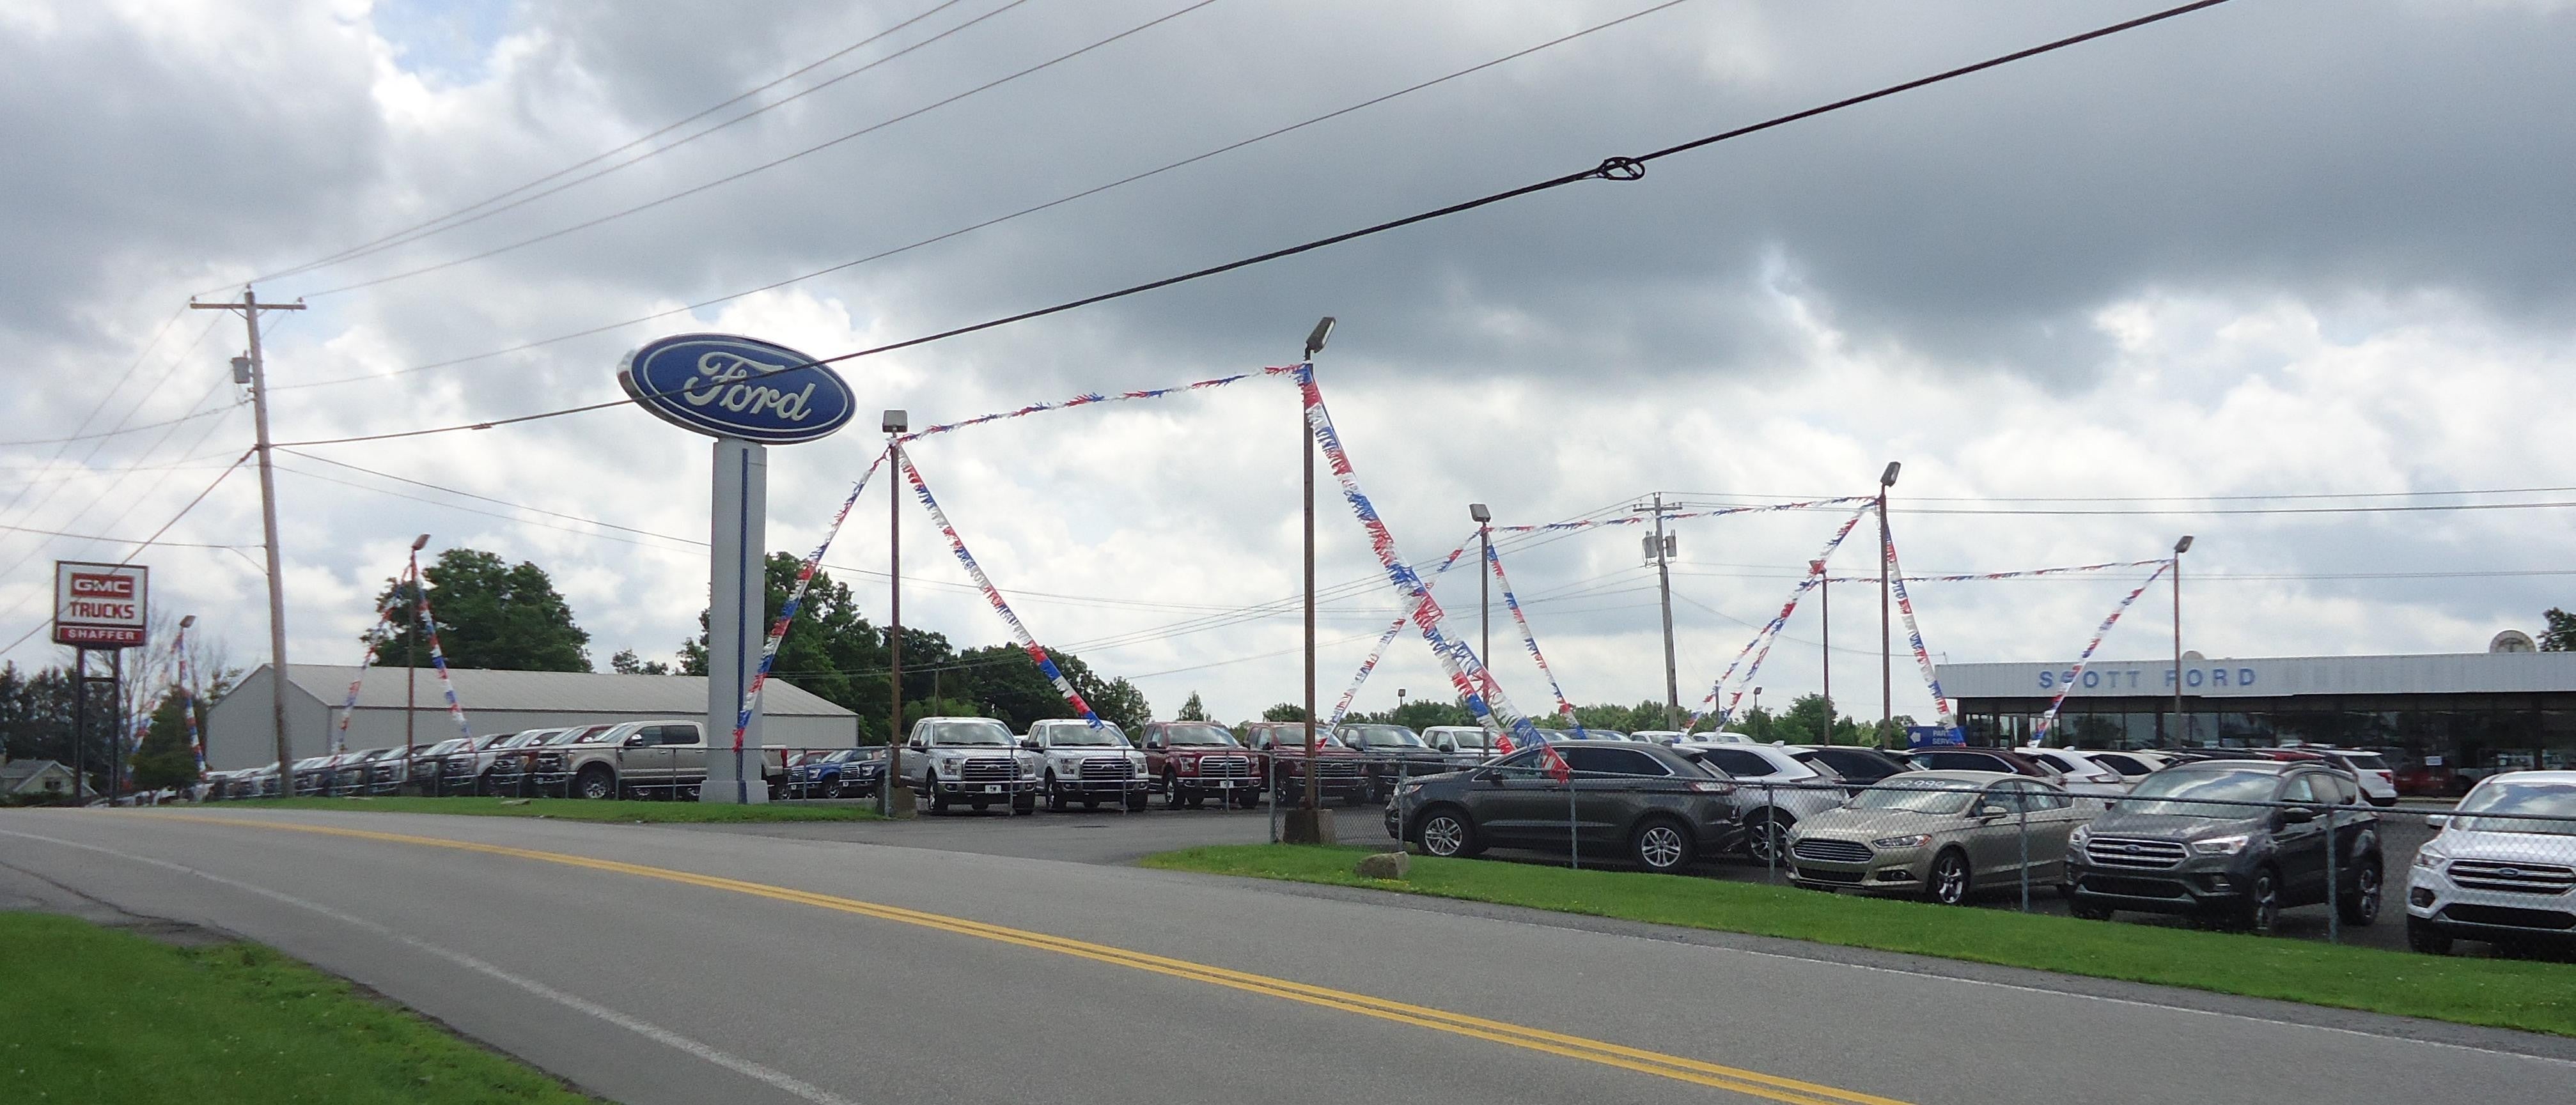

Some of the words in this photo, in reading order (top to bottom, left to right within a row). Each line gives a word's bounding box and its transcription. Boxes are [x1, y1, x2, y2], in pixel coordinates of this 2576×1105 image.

[683, 352, 816, 421] Ford
[74, 578, 130, 593] GMC
[70, 601, 135, 619] TRUCKS
[68, 629, 135, 640] SHAFFER
[2165, 668, 2256, 688] FORD
